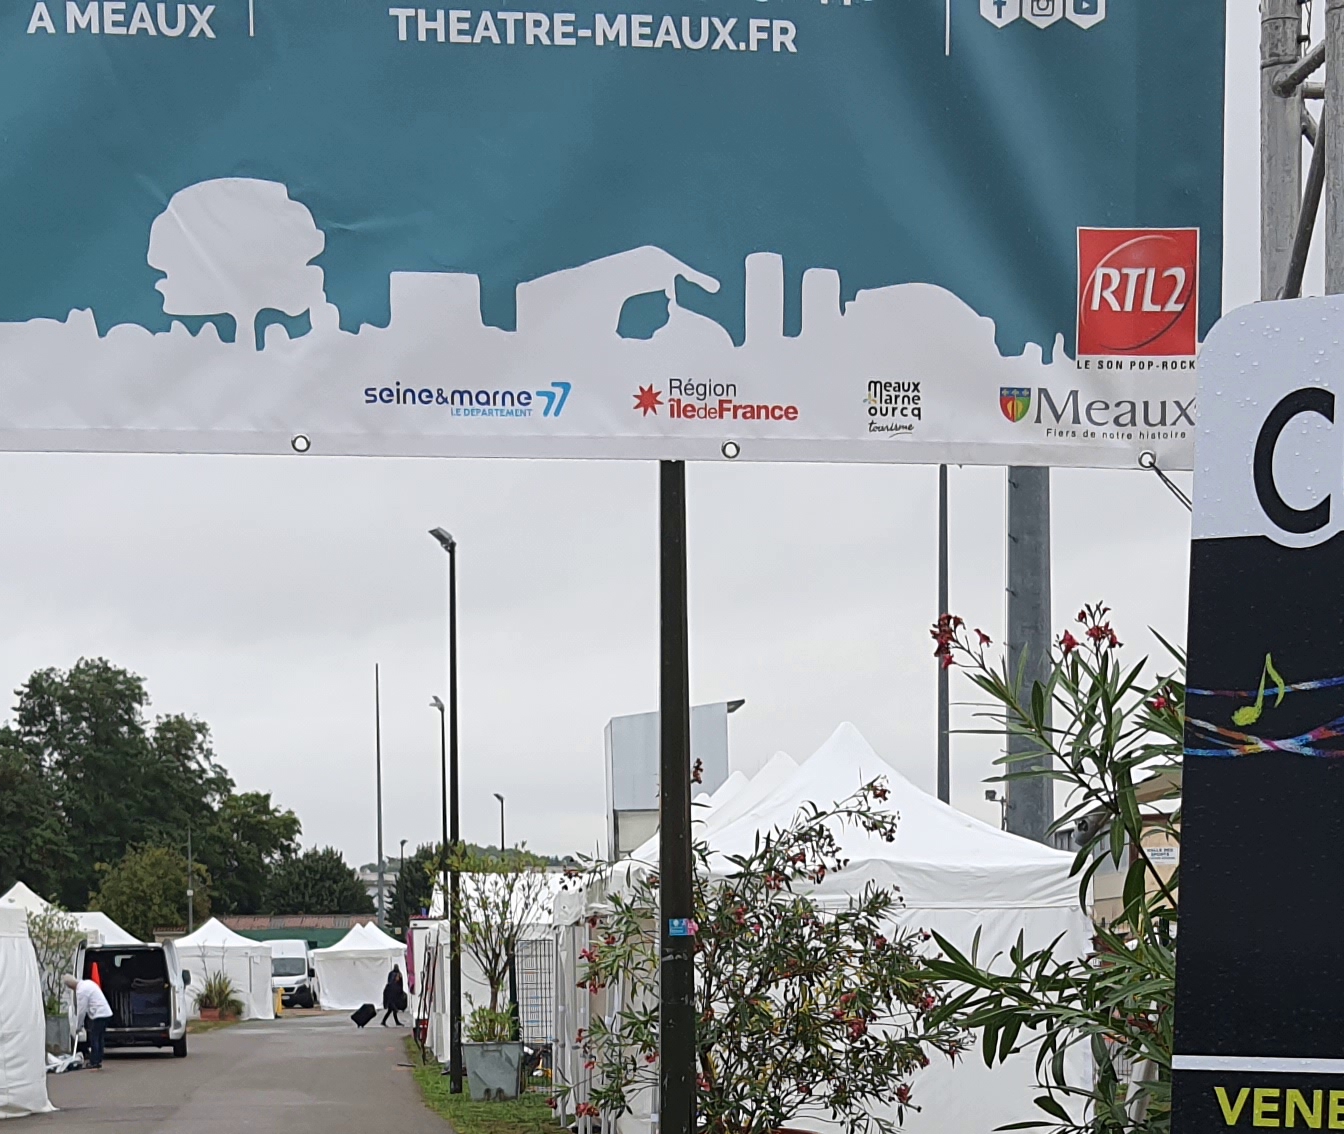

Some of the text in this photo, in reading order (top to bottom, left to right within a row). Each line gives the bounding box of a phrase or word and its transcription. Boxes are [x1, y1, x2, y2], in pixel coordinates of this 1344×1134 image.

[66, 1, 216, 38] MEAUX
[388, 8, 797, 53] THEATRE-MEAUX.FR
[1091, 267, 1186, 312] RTL2
[1077, 360, 1195, 370] LE SON POP-ROCK
[669, 378, 736, 401] Région
[451, 408, 461, 416] LE
[868, 406, 921, 420] ourcq
[1034, 387, 1196, 427] Meaux
[1046, 429, 1186, 439] Fiers de notre histoire
